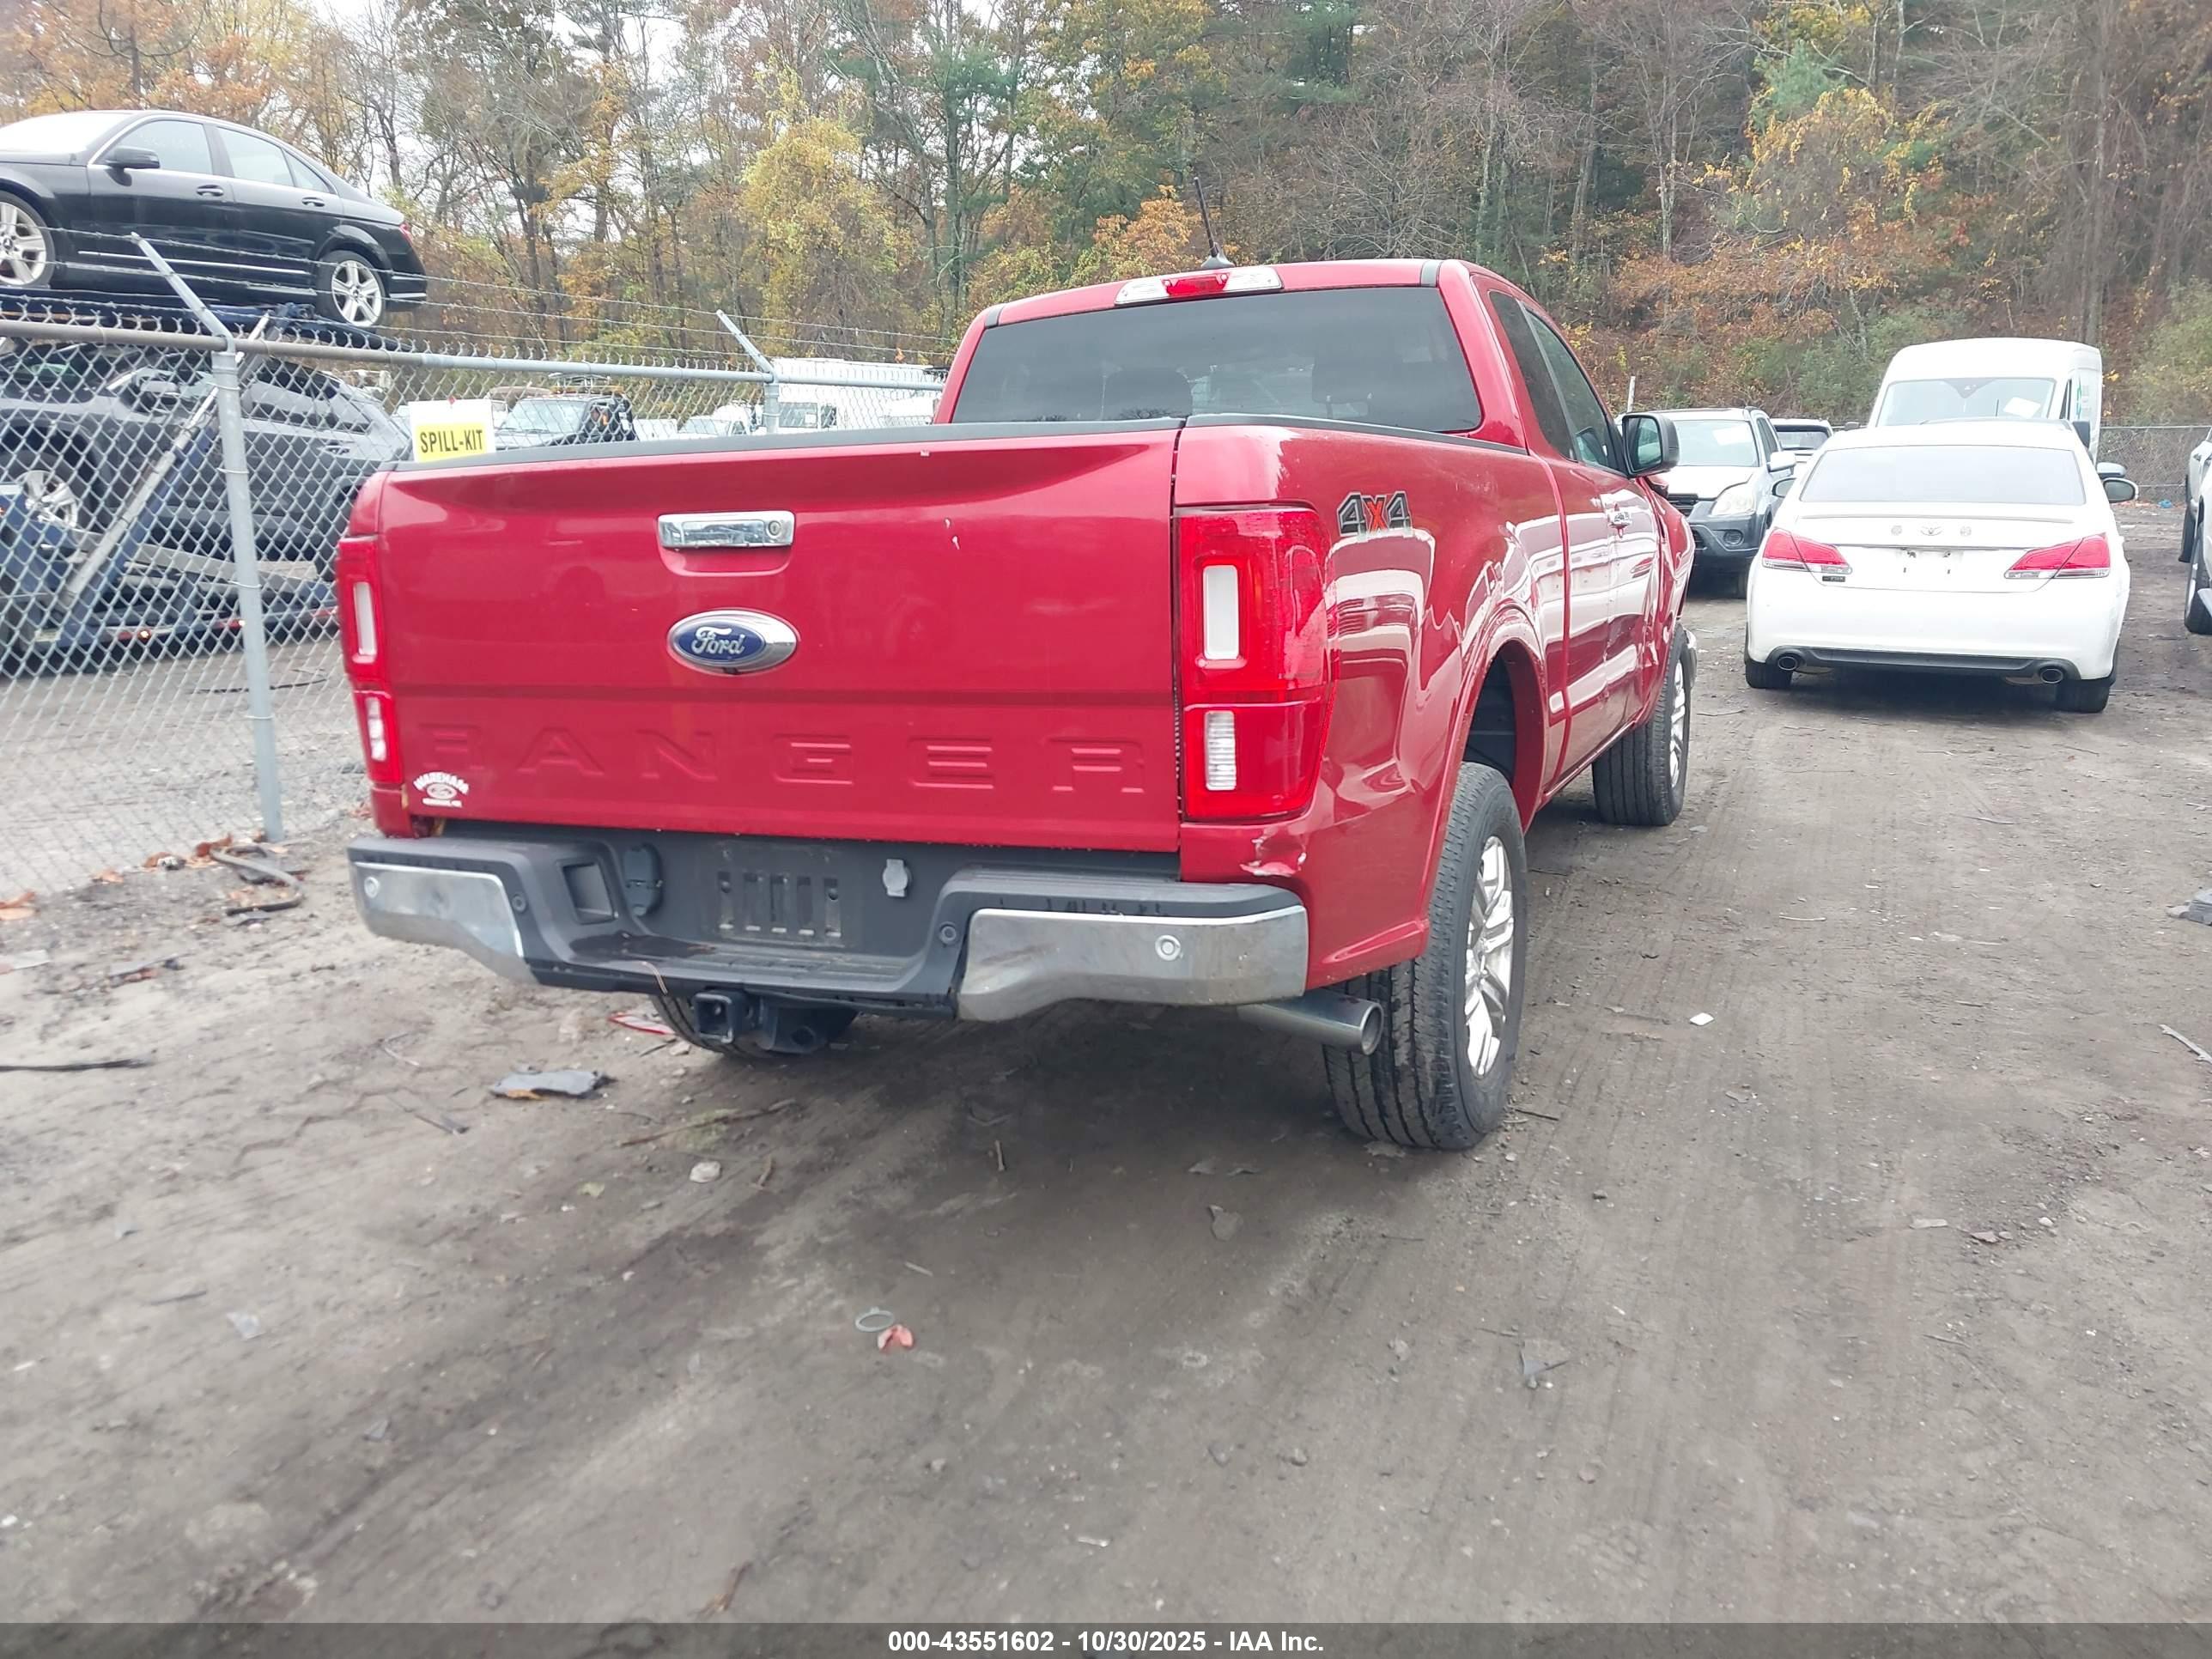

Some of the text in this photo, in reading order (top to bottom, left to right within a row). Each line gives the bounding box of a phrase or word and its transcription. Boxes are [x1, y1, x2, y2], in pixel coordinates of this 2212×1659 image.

[419, 429, 483, 453] SPILL-KIT
[690, 626, 745, 655] Ford
[417, 722, 1146, 796] RANGER
